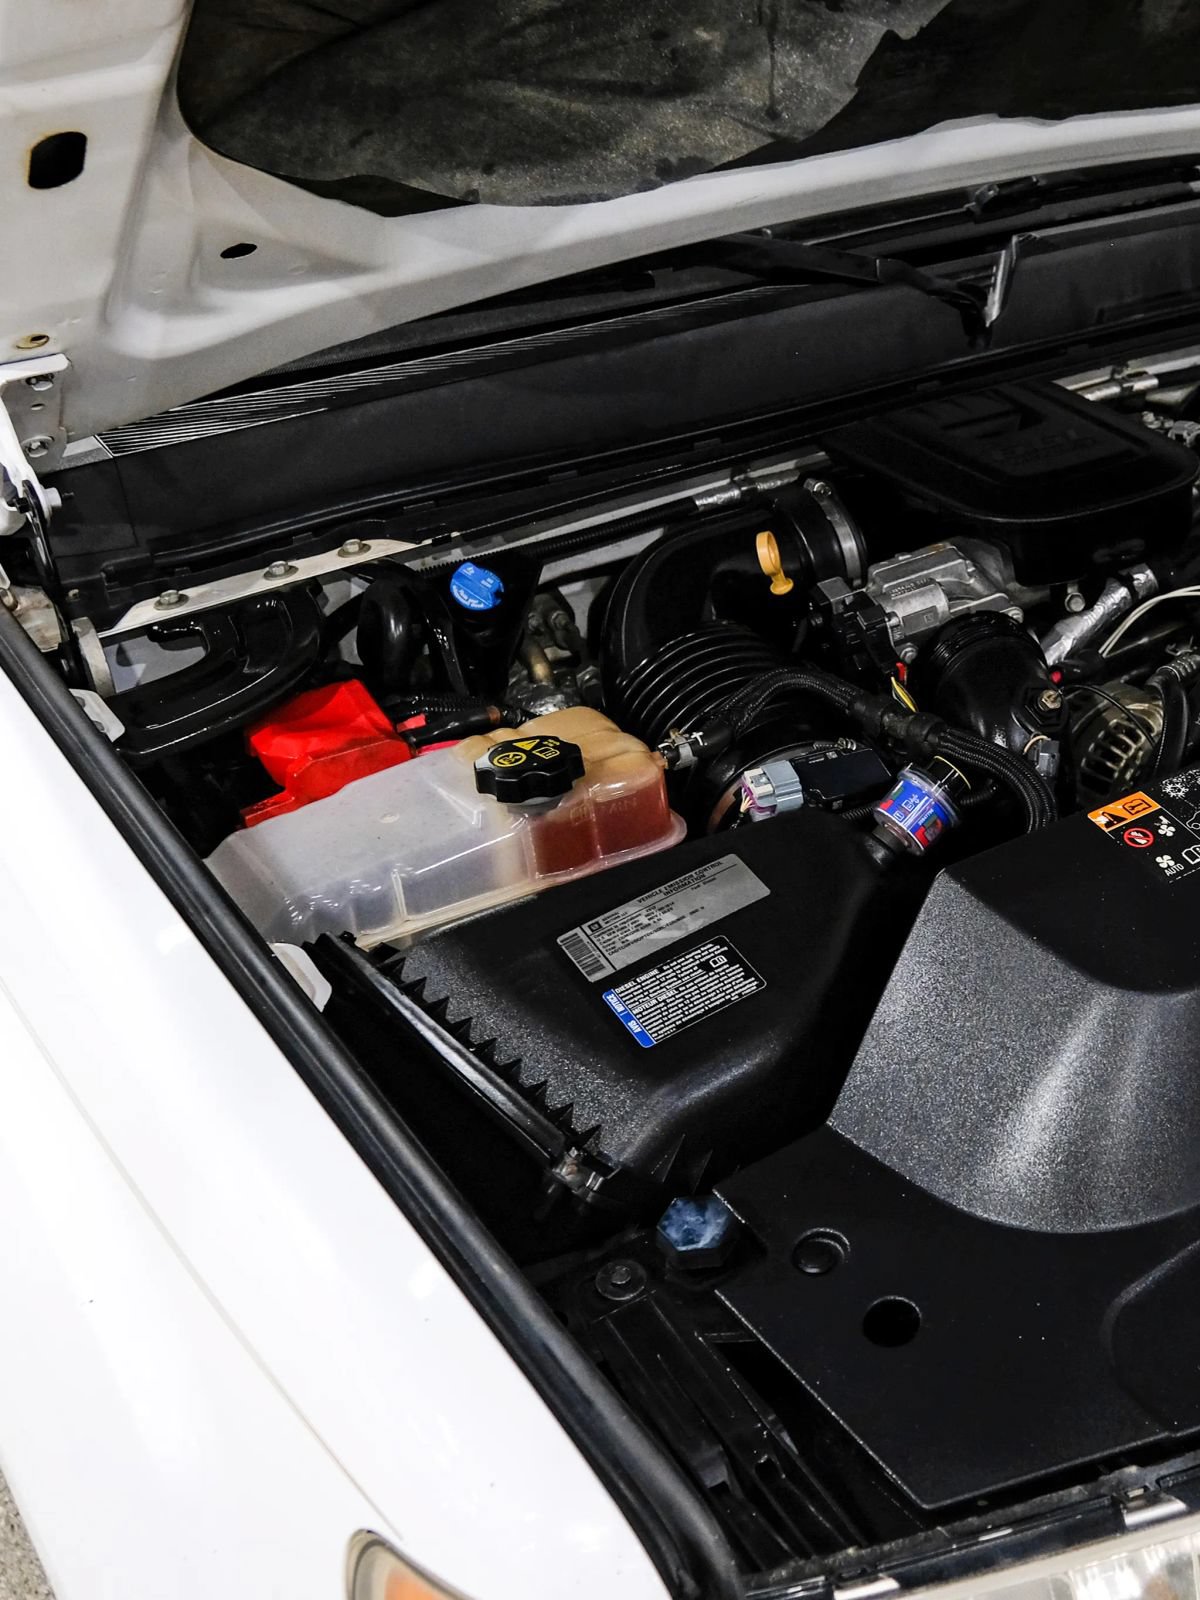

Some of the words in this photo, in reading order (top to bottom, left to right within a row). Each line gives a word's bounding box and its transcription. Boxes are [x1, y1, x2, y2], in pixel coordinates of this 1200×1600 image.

[636, 889, 662, 903] VEHICLE
[663, 874, 694, 890] EMISSION
[693, 860, 722, 876] CONTROL
[1165, 863, 1185, 877] AUTO
[662, 873, 706, 896] INFORMATION
[614, 979, 637, 993] DIESEL
[635, 968, 659, 982] ENGINE
[631, 998, 658, 1014] MOTEUR
[656, 988, 678, 1001] DIESEL
[626, 1019, 642, 1034] AVIS
